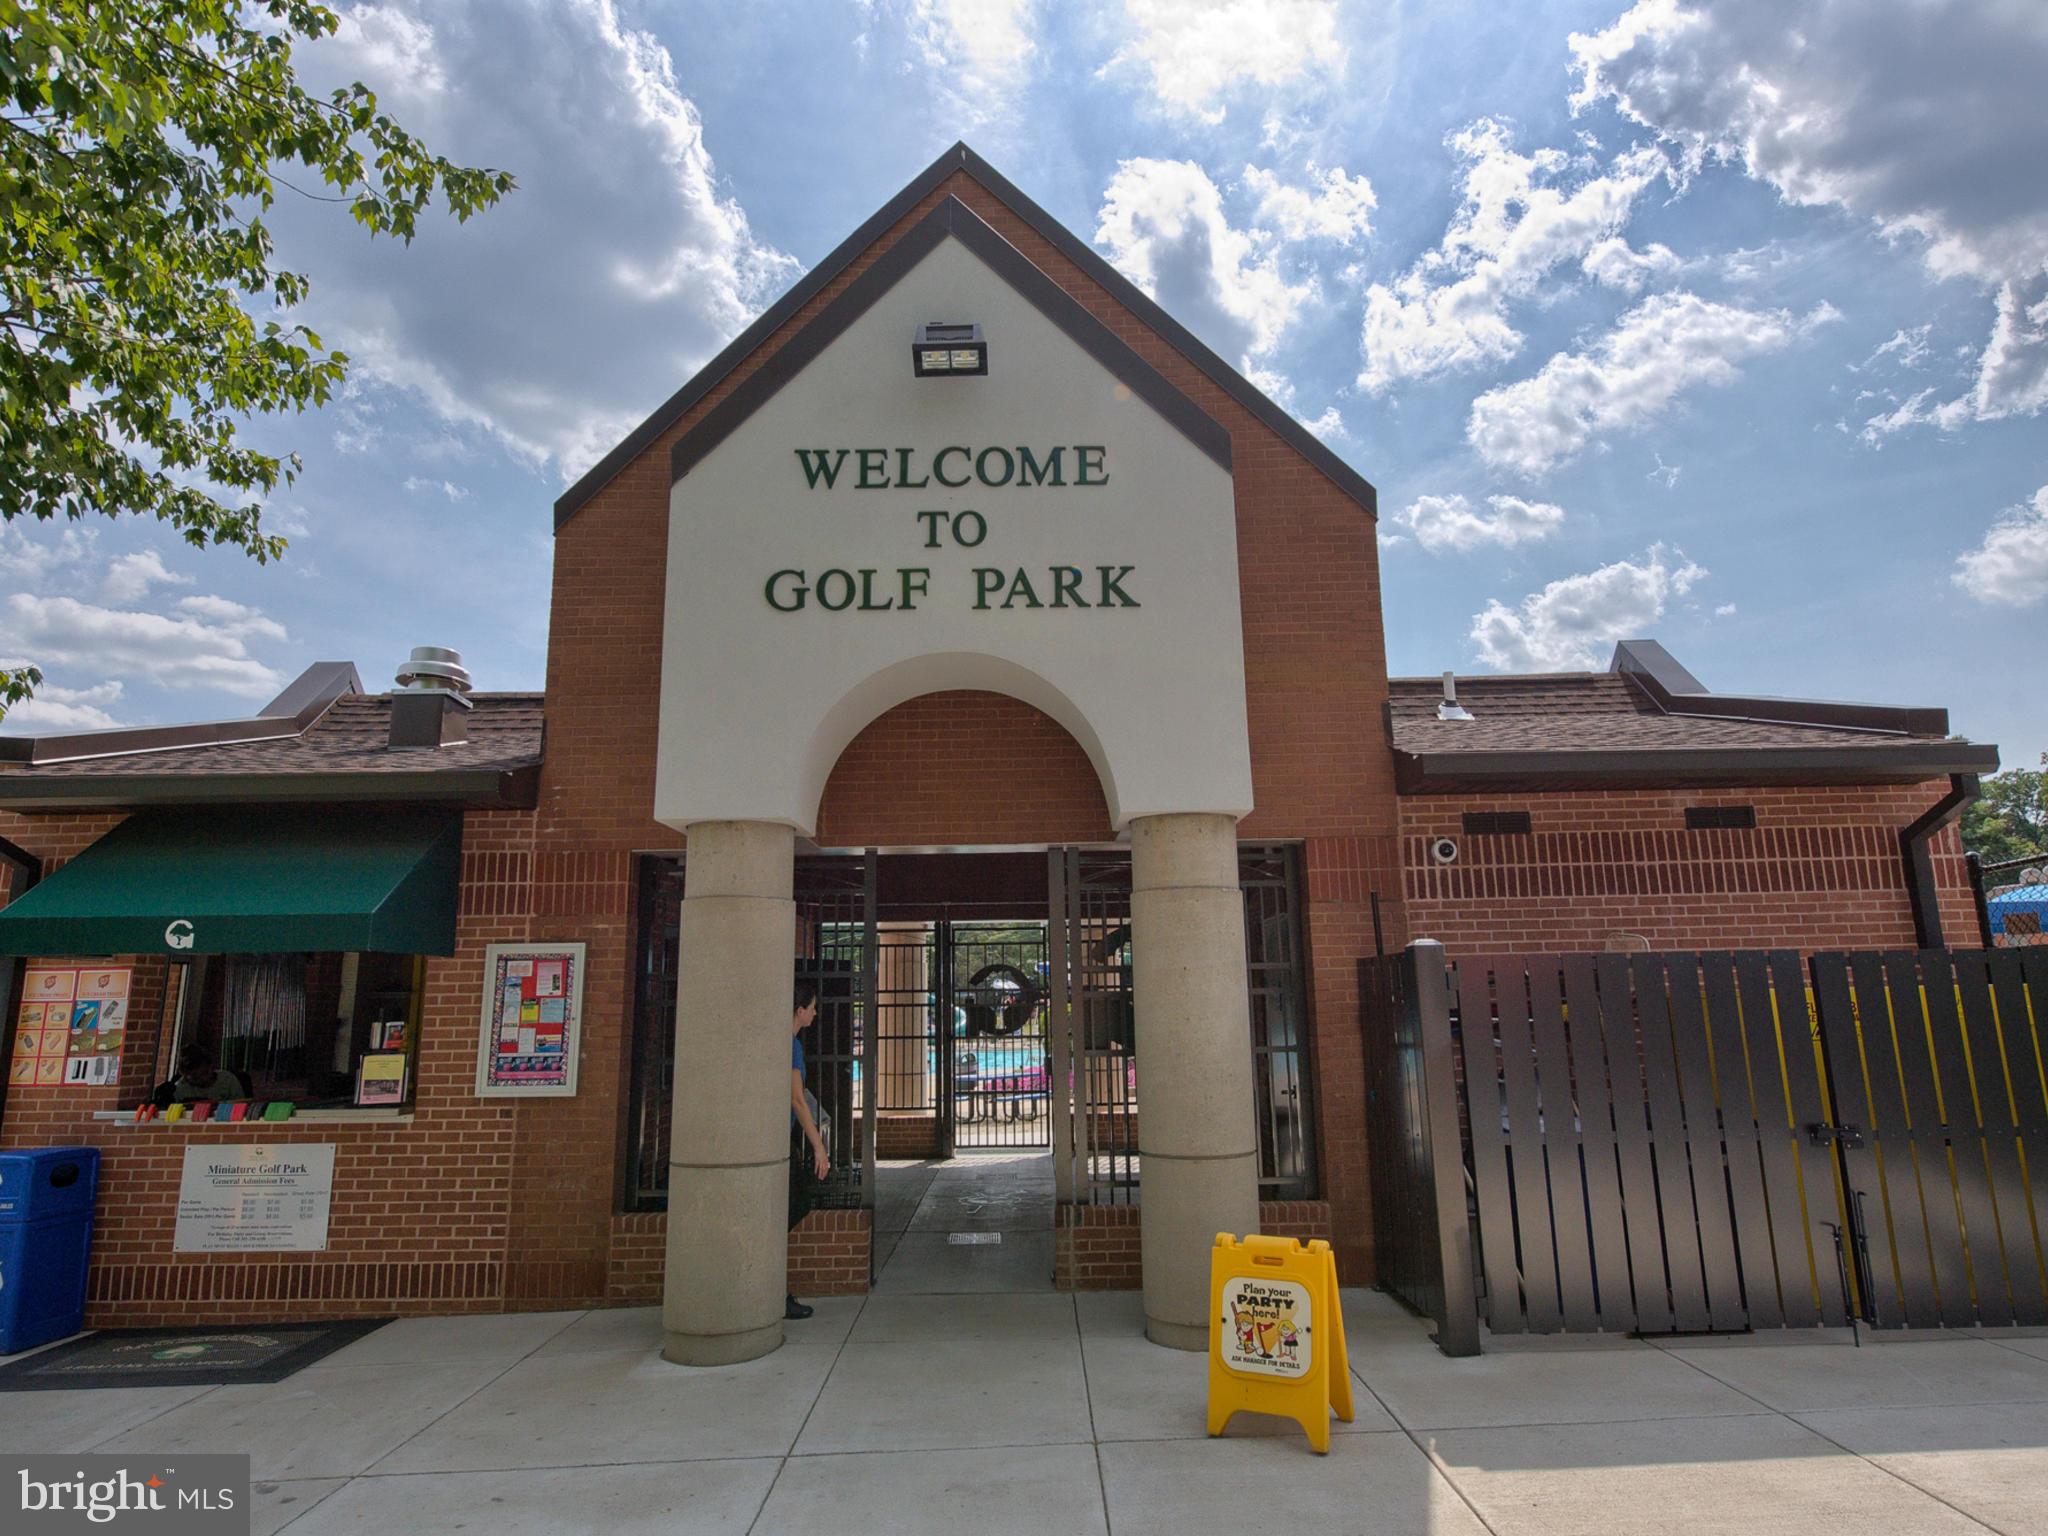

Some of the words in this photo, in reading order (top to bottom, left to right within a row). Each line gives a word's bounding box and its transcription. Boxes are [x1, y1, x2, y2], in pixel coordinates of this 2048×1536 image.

[794, 445, 1110, 489] WELCOME
[917, 510, 988, 548] TO
[764, 567, 930, 612] GOLF
[971, 566, 1141, 610] PARK
[208, 1164, 257, 1175] Miniature
[259, 1164, 281, 1174] Golf
[283, 1163, 308, 1174] Park
[242, 1177, 278, 1185] Admission
[1243, 1283, 1266, 1295] Plan
[1268, 1287, 1292, 1297] your
[1237, 1294, 1294, 1309] PARTY
[1252, 1306, 1280, 1319] here!
[1243, 1357, 1267, 1366] MANAGER
[1279, 1361, 1301, 1369] DETAILS
